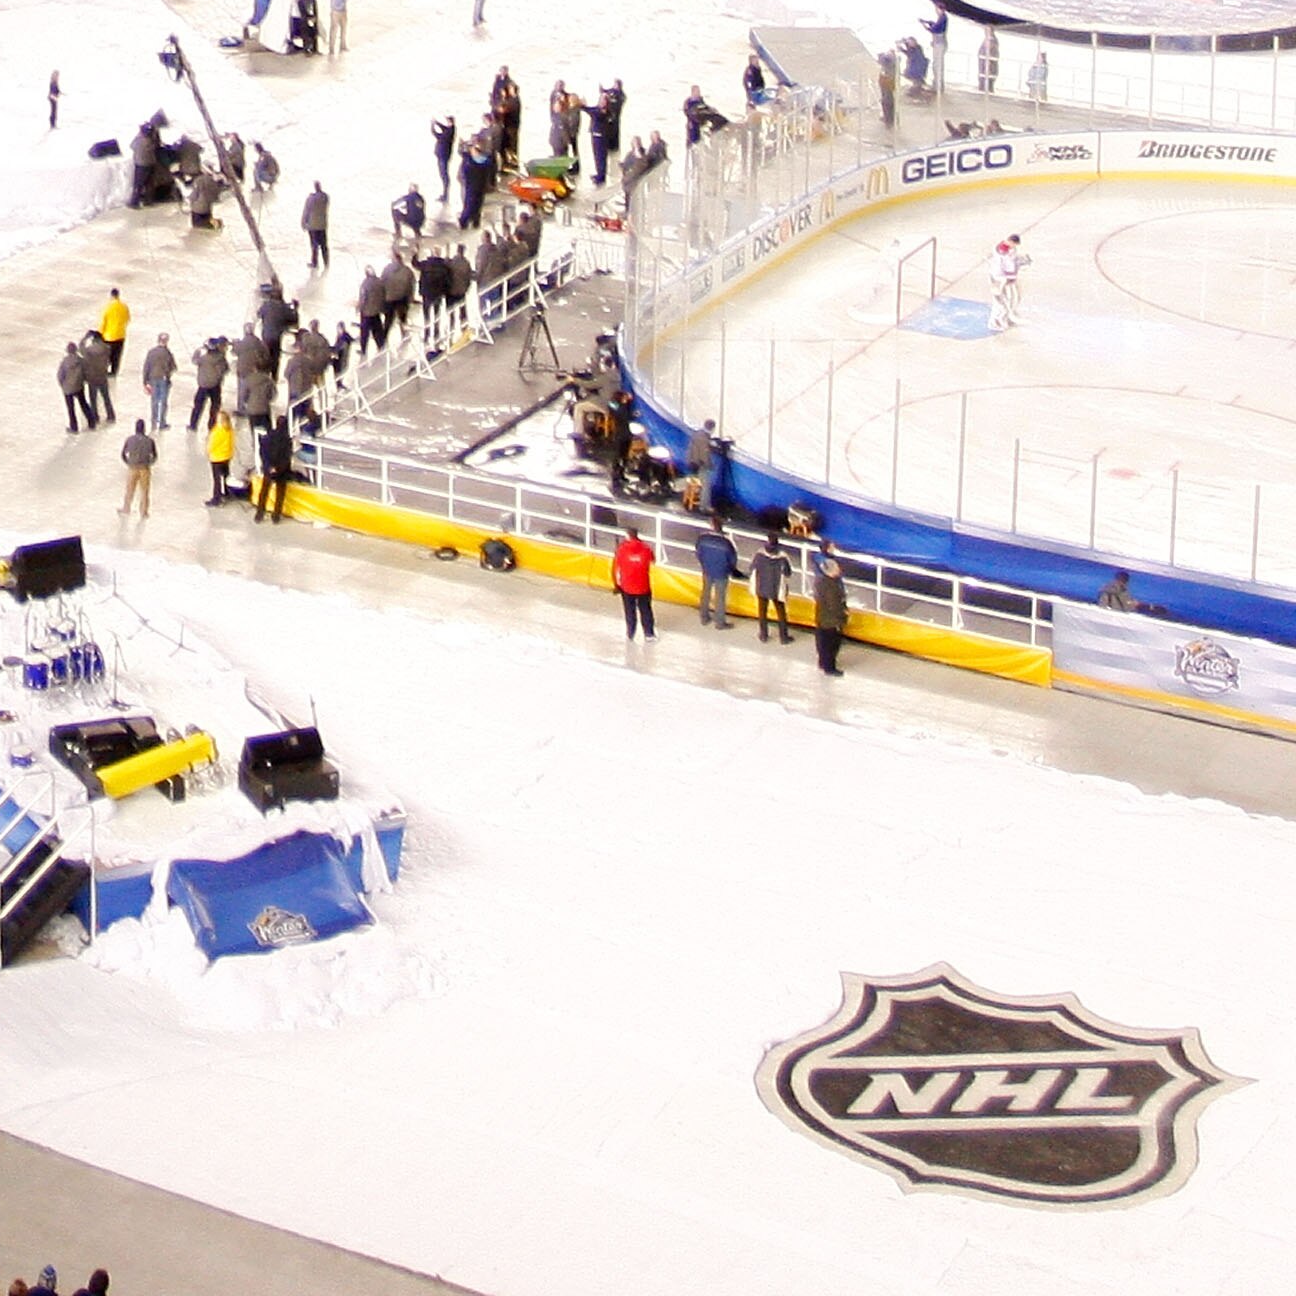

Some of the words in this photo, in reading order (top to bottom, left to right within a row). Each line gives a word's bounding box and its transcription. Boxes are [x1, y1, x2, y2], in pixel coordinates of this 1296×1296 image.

[901, 144, 1014, 184] GEICO
[1136, 140, 1278, 163] BRIDGESTONE
[752, 203, 813, 261] DISCOVER
[846, 1067, 1135, 1115] NHL
